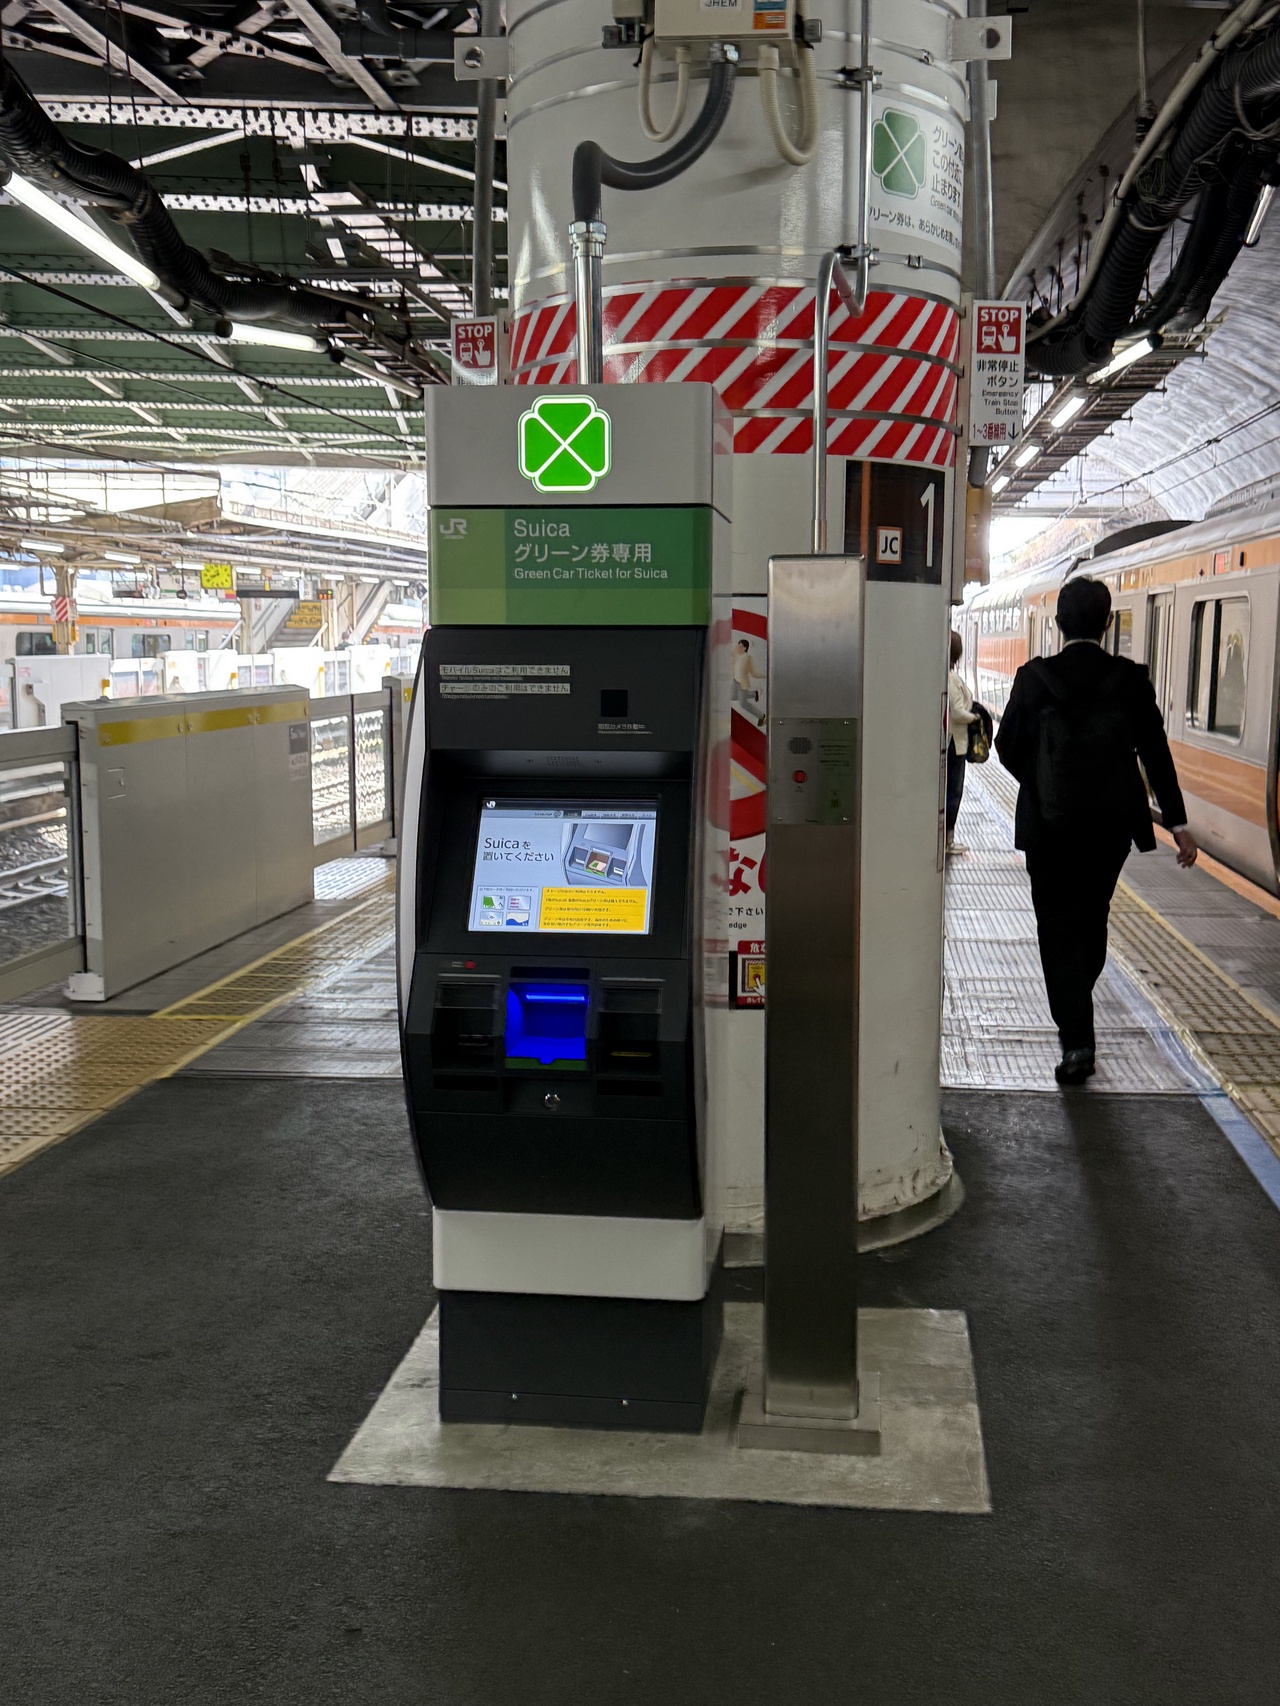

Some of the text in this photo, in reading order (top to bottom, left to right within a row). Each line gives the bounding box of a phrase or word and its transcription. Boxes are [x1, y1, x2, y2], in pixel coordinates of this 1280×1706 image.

[980, 309, 1019, 322] STOP
[458, 325, 492, 338] STOP
[986, 374, 1019, 388] ボタン
[981, 389, 1019, 398] Emergency
[995, 408, 1018, 416] Button
[439, 518, 468, 535] JR
[514, 518, 571, 537] Suica
[920, 482, 935, 568] 1
[881, 536, 899, 554] JC
[514, 542, 652, 563] グリーン券専用
[514, 567, 668, 579] Green Car Ticket for Suica
[482, 851, 555, 862] 置いてください
